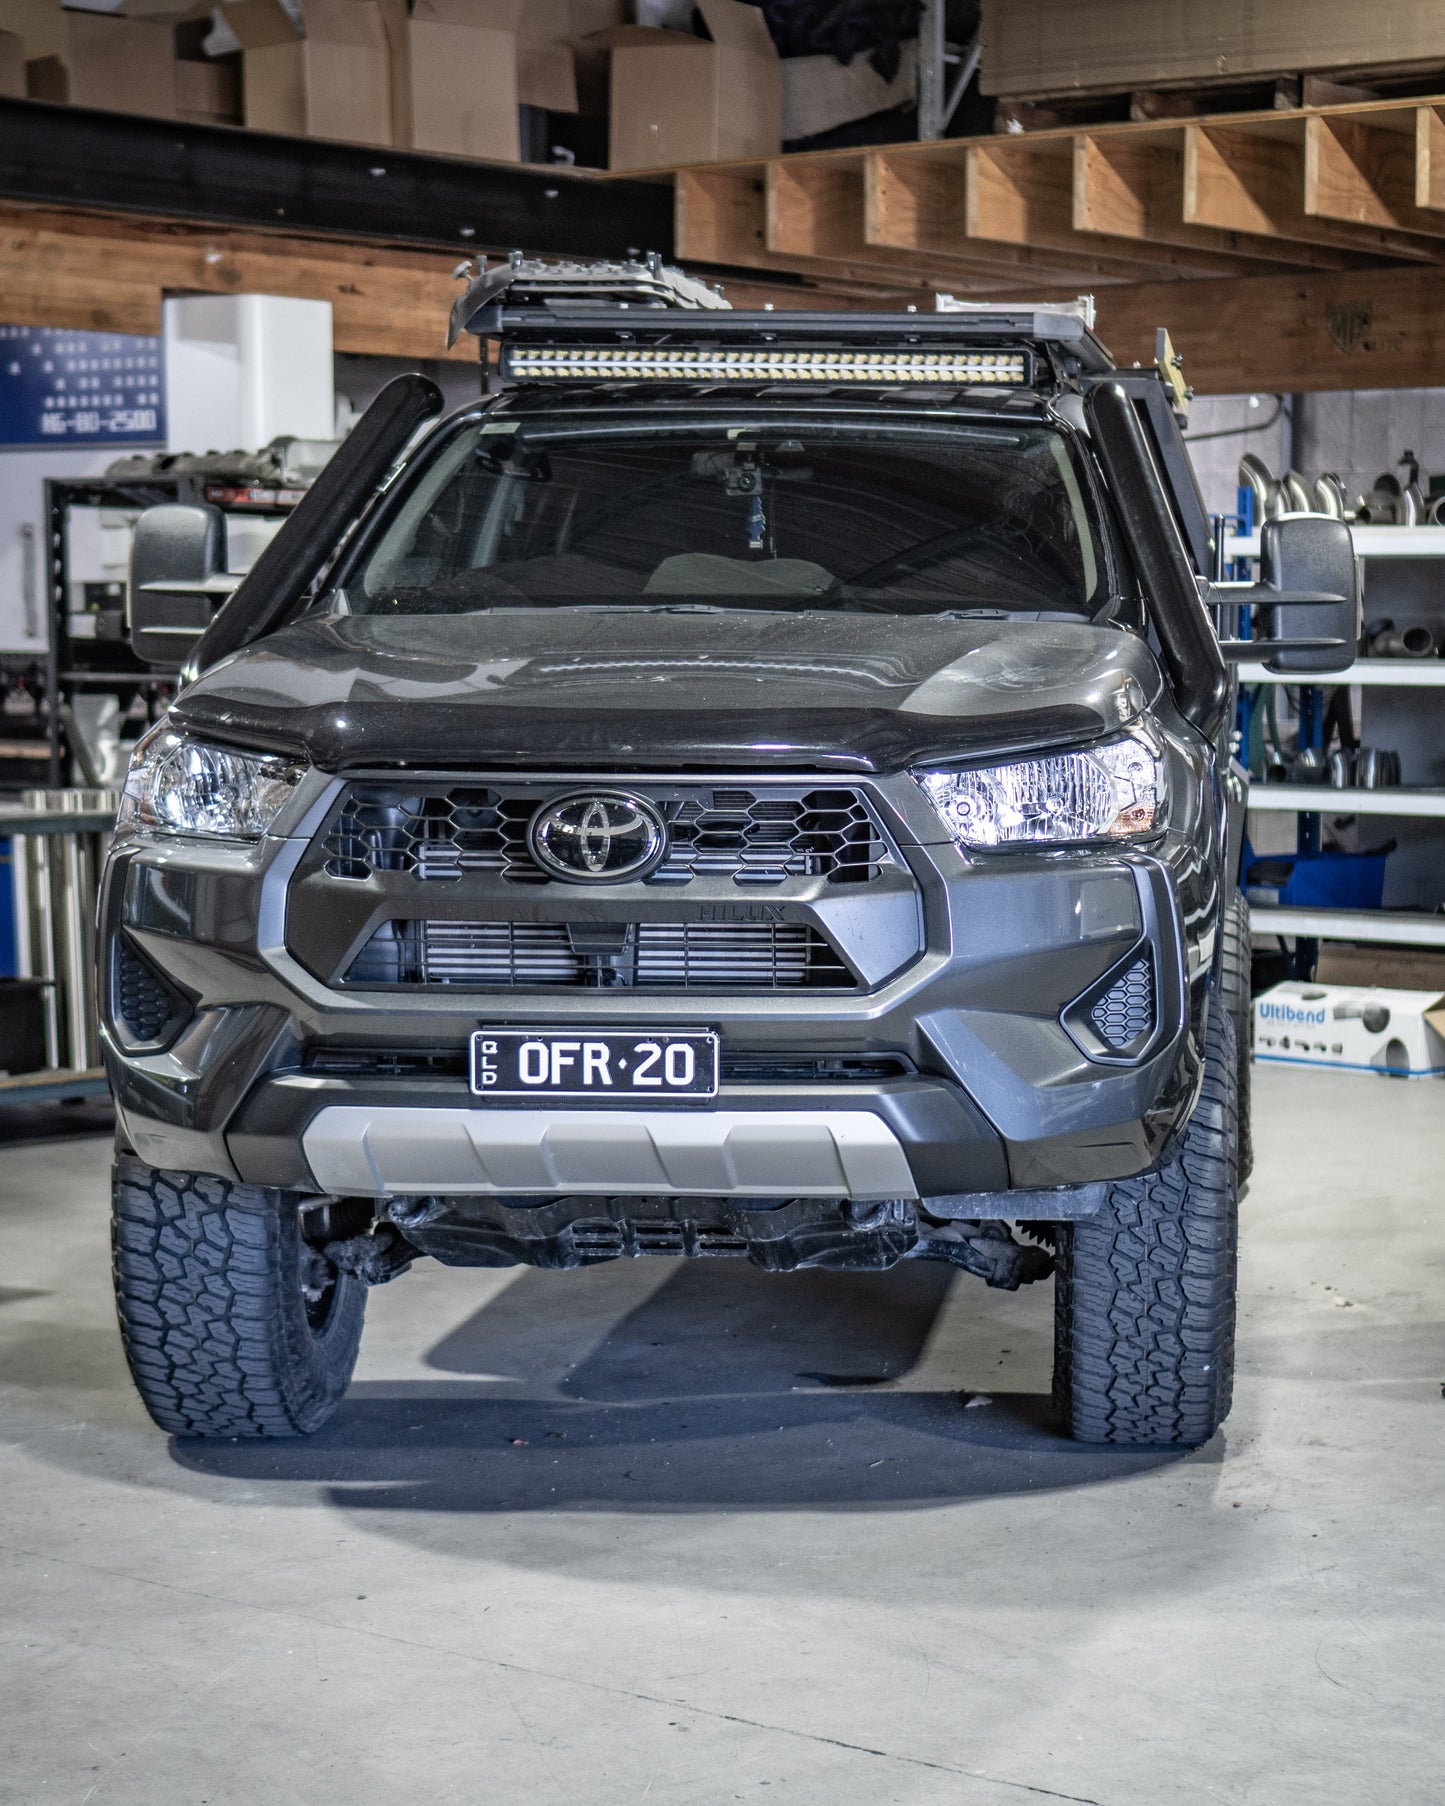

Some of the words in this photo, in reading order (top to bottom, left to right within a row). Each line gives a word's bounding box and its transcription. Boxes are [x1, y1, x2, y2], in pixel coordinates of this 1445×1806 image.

[699, 905, 786, 921] HILUX
[1259, 1002, 1326, 1025] Ultibend
[481, 1040, 498, 1085] QLD
